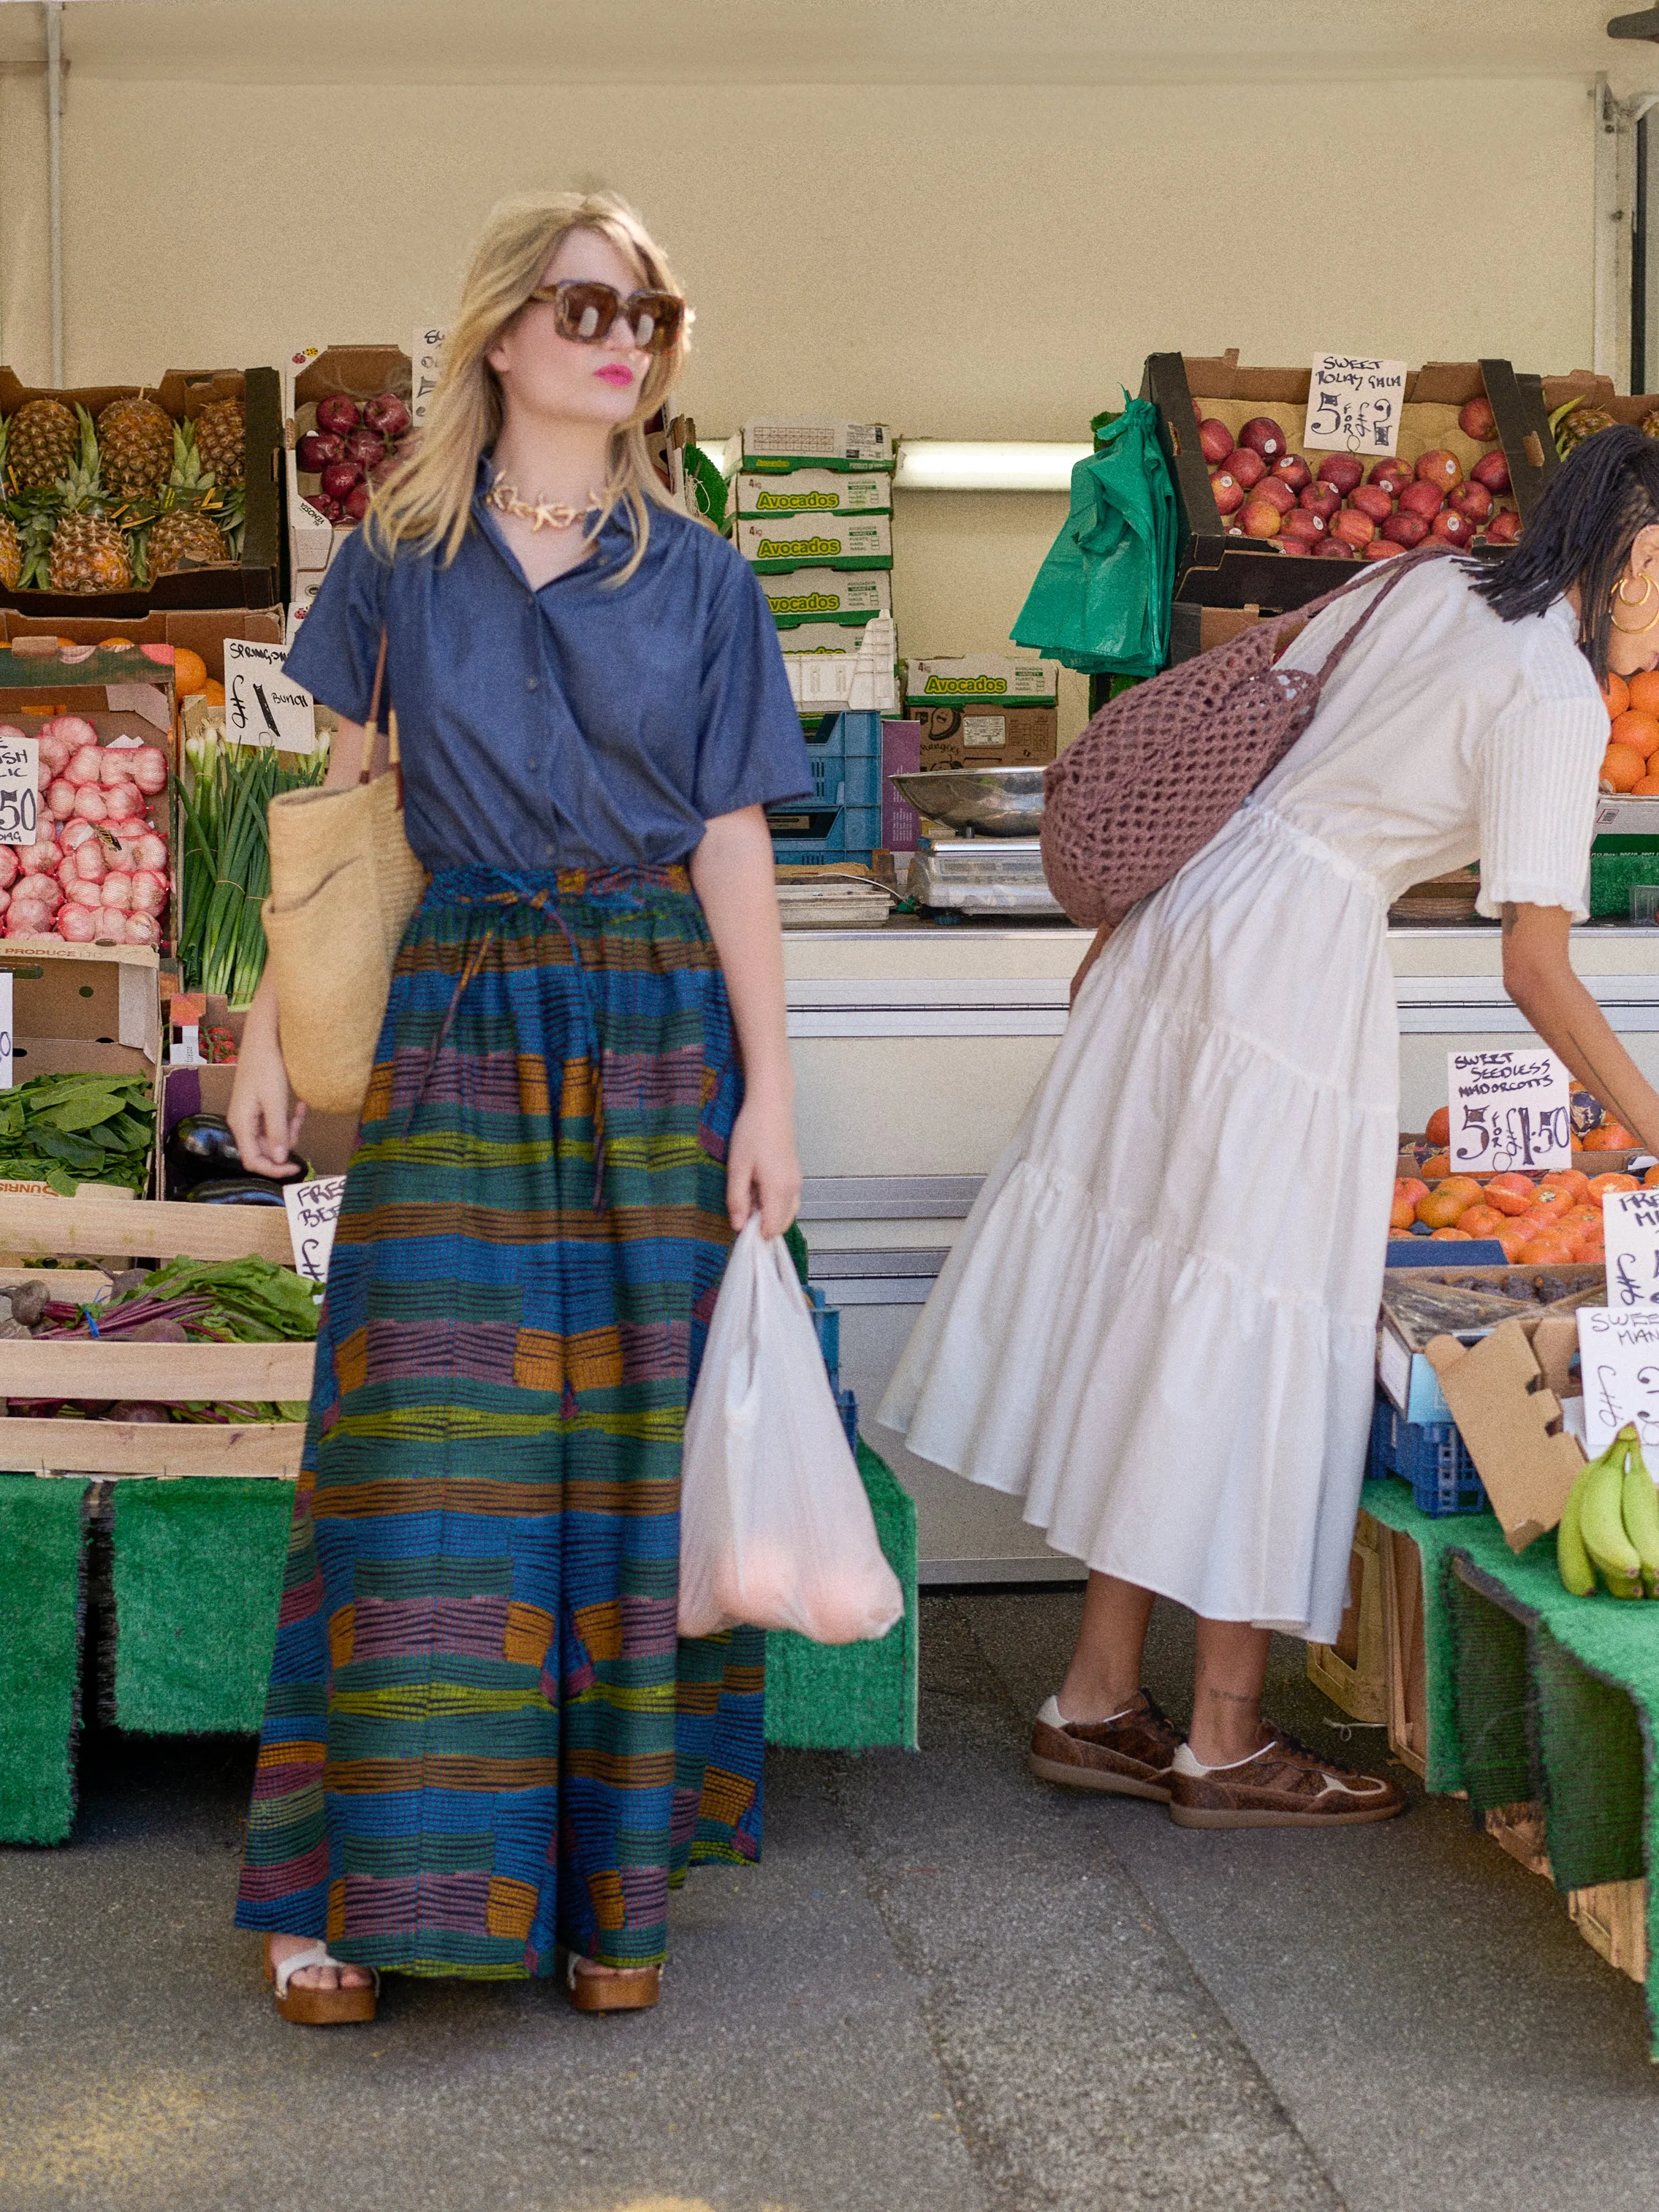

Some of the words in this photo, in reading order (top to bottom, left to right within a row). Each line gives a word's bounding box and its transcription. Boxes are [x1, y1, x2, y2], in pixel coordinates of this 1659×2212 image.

[1323, 356, 1383, 370] SWEET
[1311, 392, 1342, 435] 5
[1343, 403, 1354, 435] FOR
[756, 491, 840, 510] Avocados
[300, 502, 325, 525] VENOSTA
[757, 536, 841, 558] Avocados
[766, 593, 840, 612] vocados
[924, 674, 1008, 693] Avocados
[271, 692, 308, 707] BUNCH
[6, 949, 76, 957] PRODUCE
[1454, 1052, 1514, 1069] SWEET
[1470, 1059, 1550, 1082] SEEDLESS
[1457, 1104, 1490, 1160] 5
[1492, 1111, 1503, 1148] FOR
